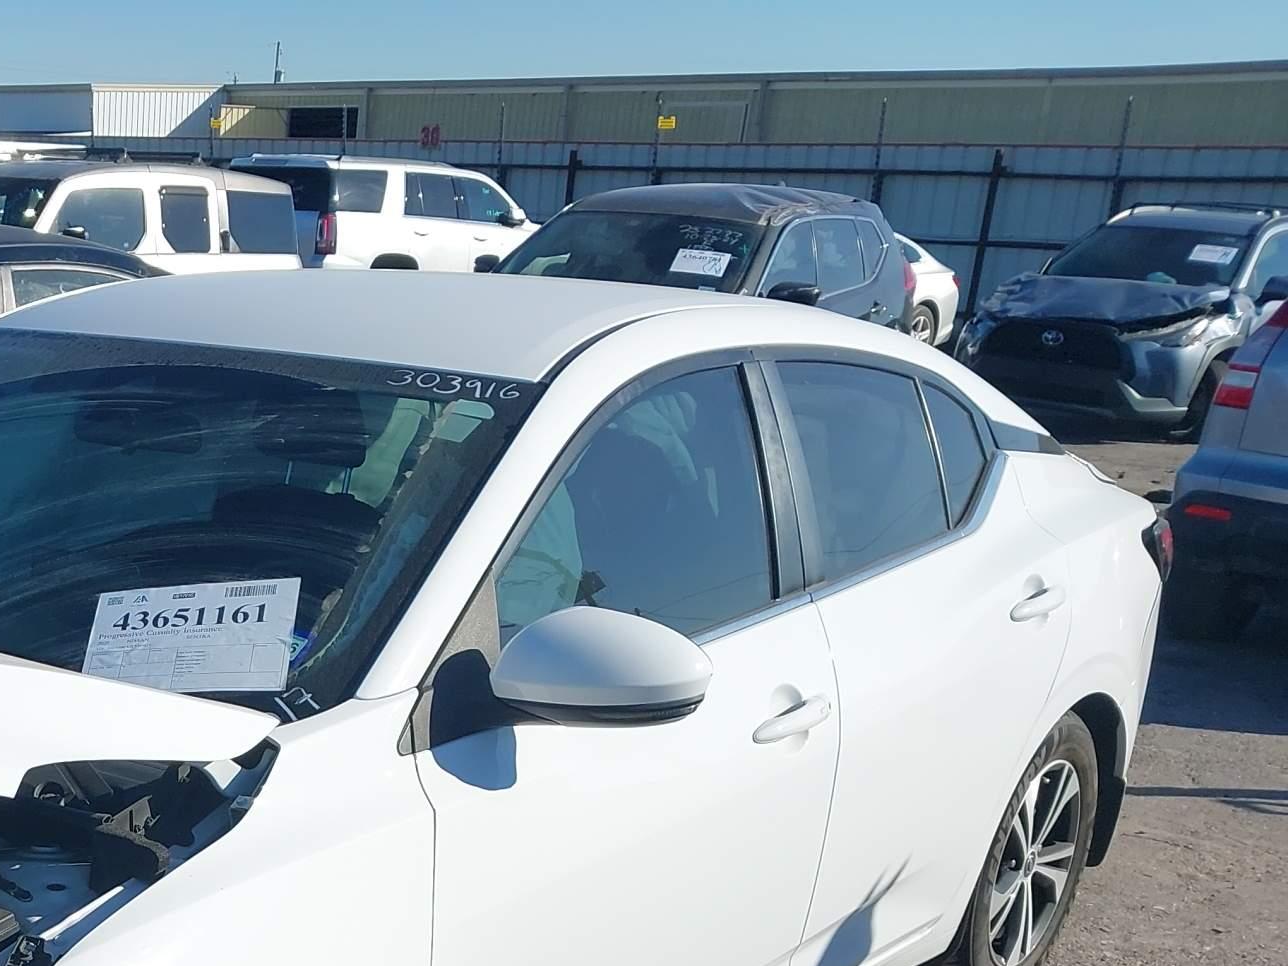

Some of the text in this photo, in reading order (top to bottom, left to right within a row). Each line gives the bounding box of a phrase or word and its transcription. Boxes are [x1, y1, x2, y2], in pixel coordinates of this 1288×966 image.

[386, 369, 521, 399] 303916
[113, 603, 269, 631] 43651161
[98, 631, 146, 641] Progressive
